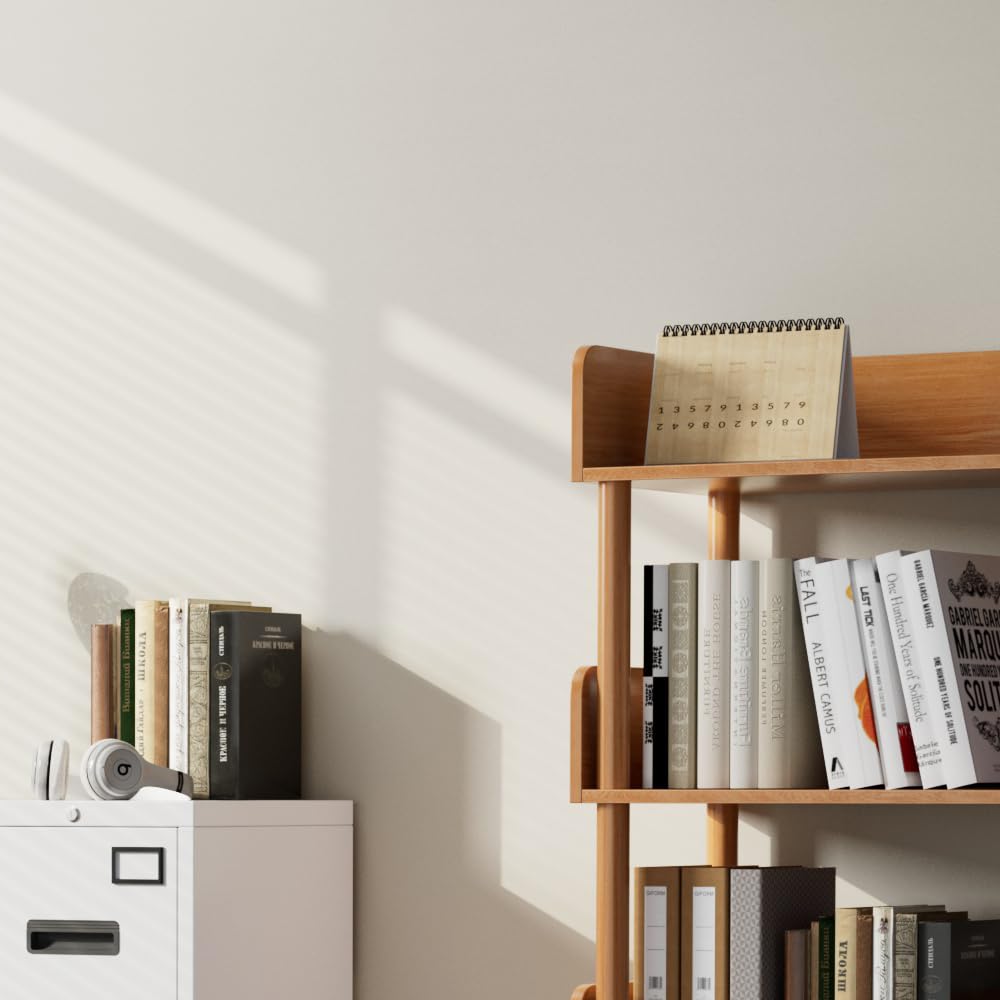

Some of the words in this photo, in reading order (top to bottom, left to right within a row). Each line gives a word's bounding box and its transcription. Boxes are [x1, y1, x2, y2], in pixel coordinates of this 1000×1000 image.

[658, 406, 664, 414] 1
[673, 405, 680, 414] 3
[689, 405, 696, 413] 5
[704, 404, 711, 412] 7
[720, 404, 727, 412] 9
[736, 403, 742, 411] 1
[752, 403, 759, 411] 3
[768, 402, 774, 410] 5
[784, 401, 791, 409] 7
[798, 401, 806, 409] 9
[860, 586, 872, 606] LAST
[886, 573, 899, 595] One
[800, 579, 820, 625] FALL
[863, 608, 875, 627] TICK
[890, 596, 911, 641] Hundred
[948, 606, 984, 627] GABRIEL
[137, 631, 147, 681] ШКОЛА
[900, 640, 913, 668] Years
[811, 641, 829, 688] ALBERT
[820, 693, 837, 735] CAMUS
[906, 670, 920, 681] of
[908, 682, 928, 723] Solitude
[837, 940, 848, 993] ШКОЛА
